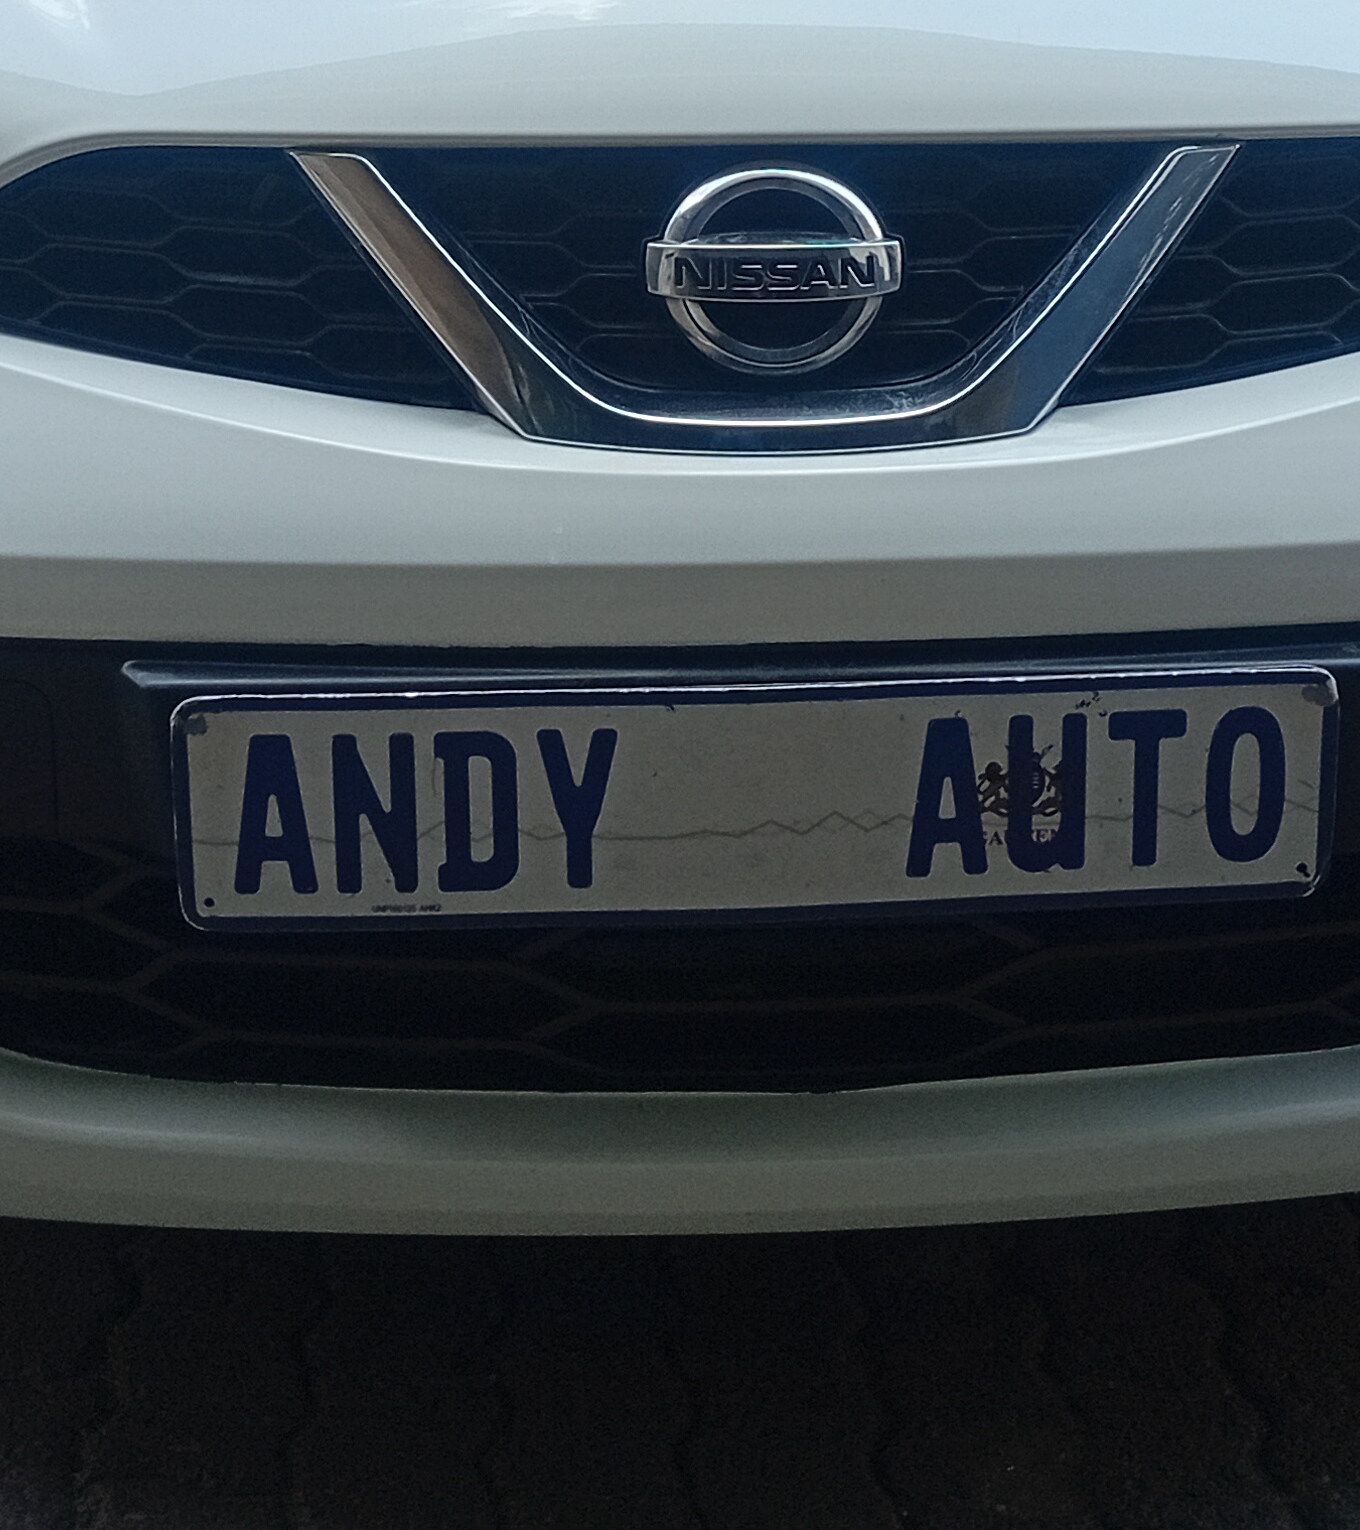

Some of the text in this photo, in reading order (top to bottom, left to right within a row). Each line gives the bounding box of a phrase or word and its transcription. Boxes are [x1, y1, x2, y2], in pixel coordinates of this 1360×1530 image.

[673, 254, 875, 292] NISSAN
[232, 705, 1286, 895] ANDY AUTO
